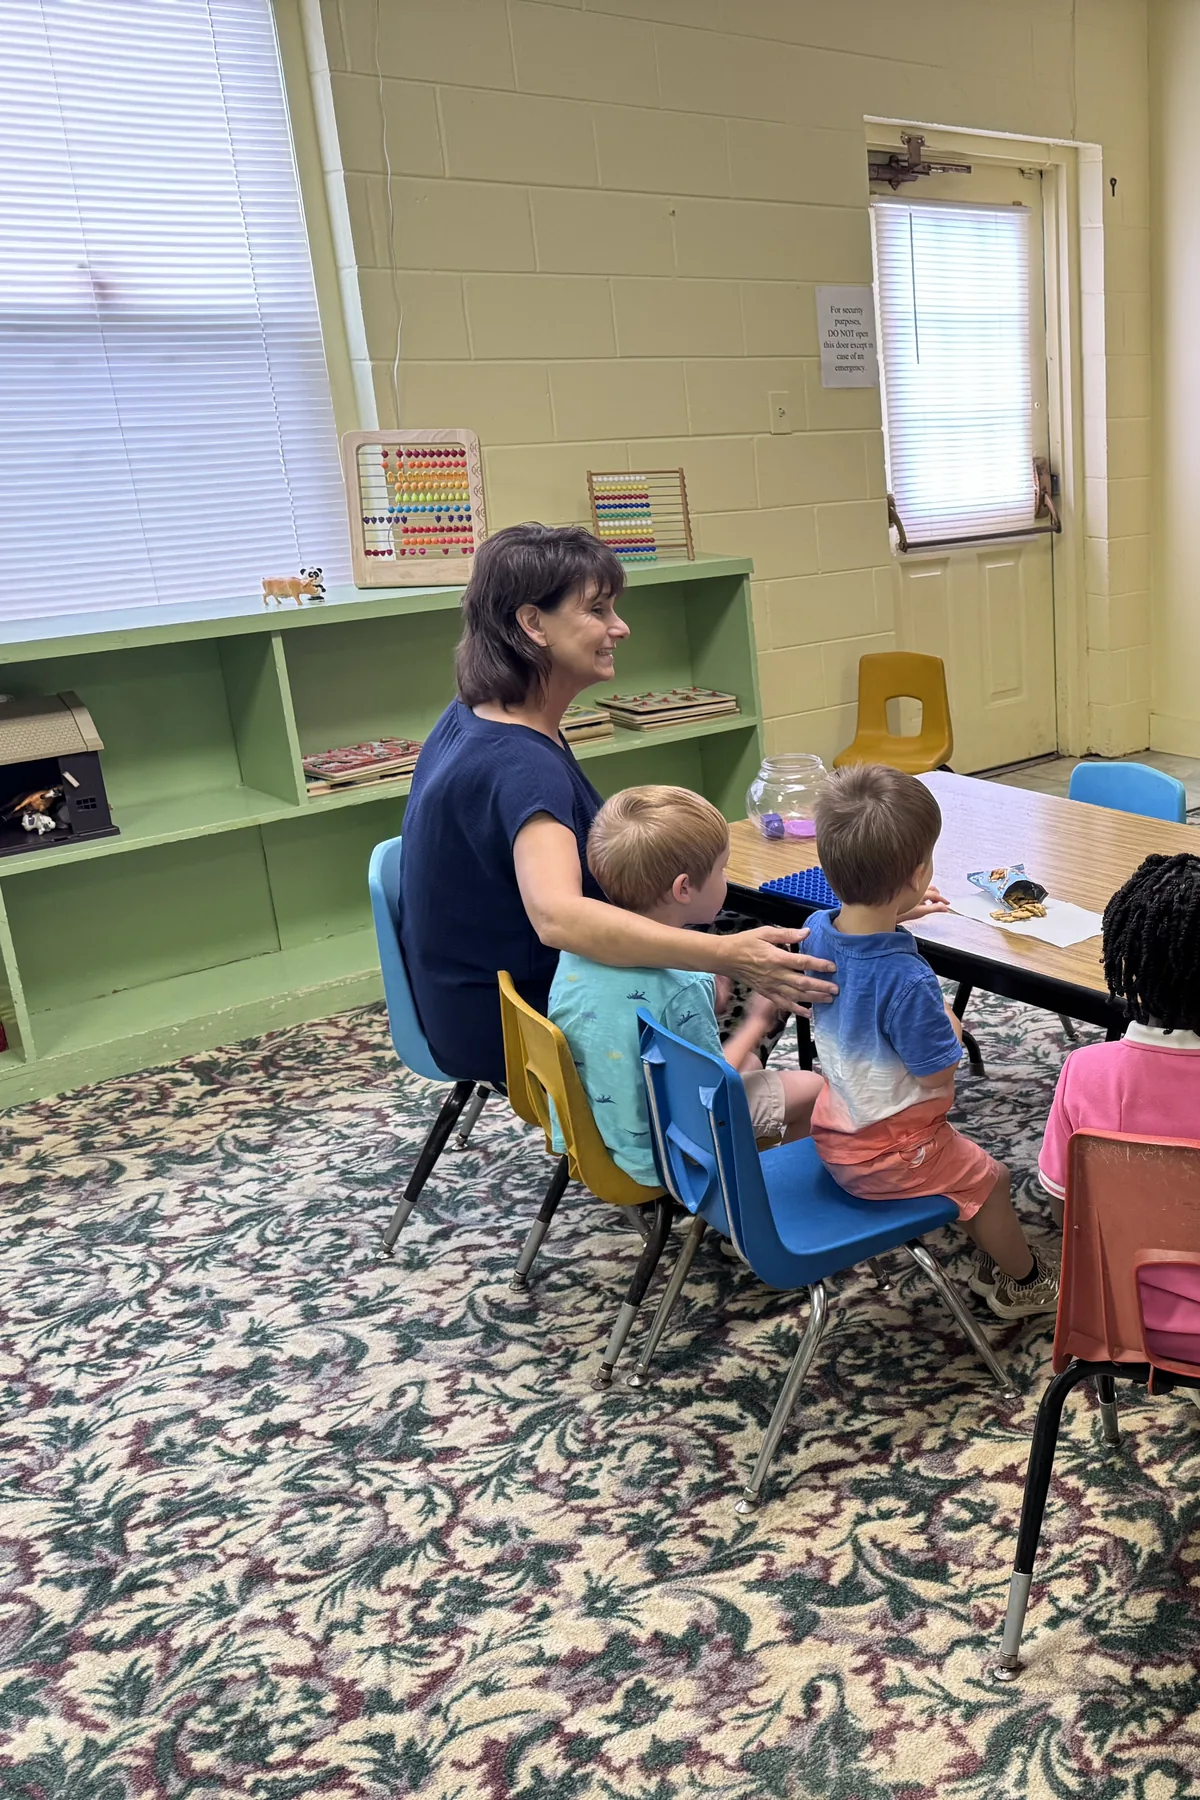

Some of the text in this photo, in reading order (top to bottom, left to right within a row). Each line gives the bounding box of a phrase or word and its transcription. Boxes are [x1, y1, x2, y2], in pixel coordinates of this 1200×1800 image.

[830, 305, 863, 316] For security
[856, 331, 869, 339] open
[823, 341, 835, 349] this
[836, 341, 849, 349] door
[850, 342, 868, 350] except
[850, 351, 857, 360] of
[834, 365, 867, 373] emergency.
